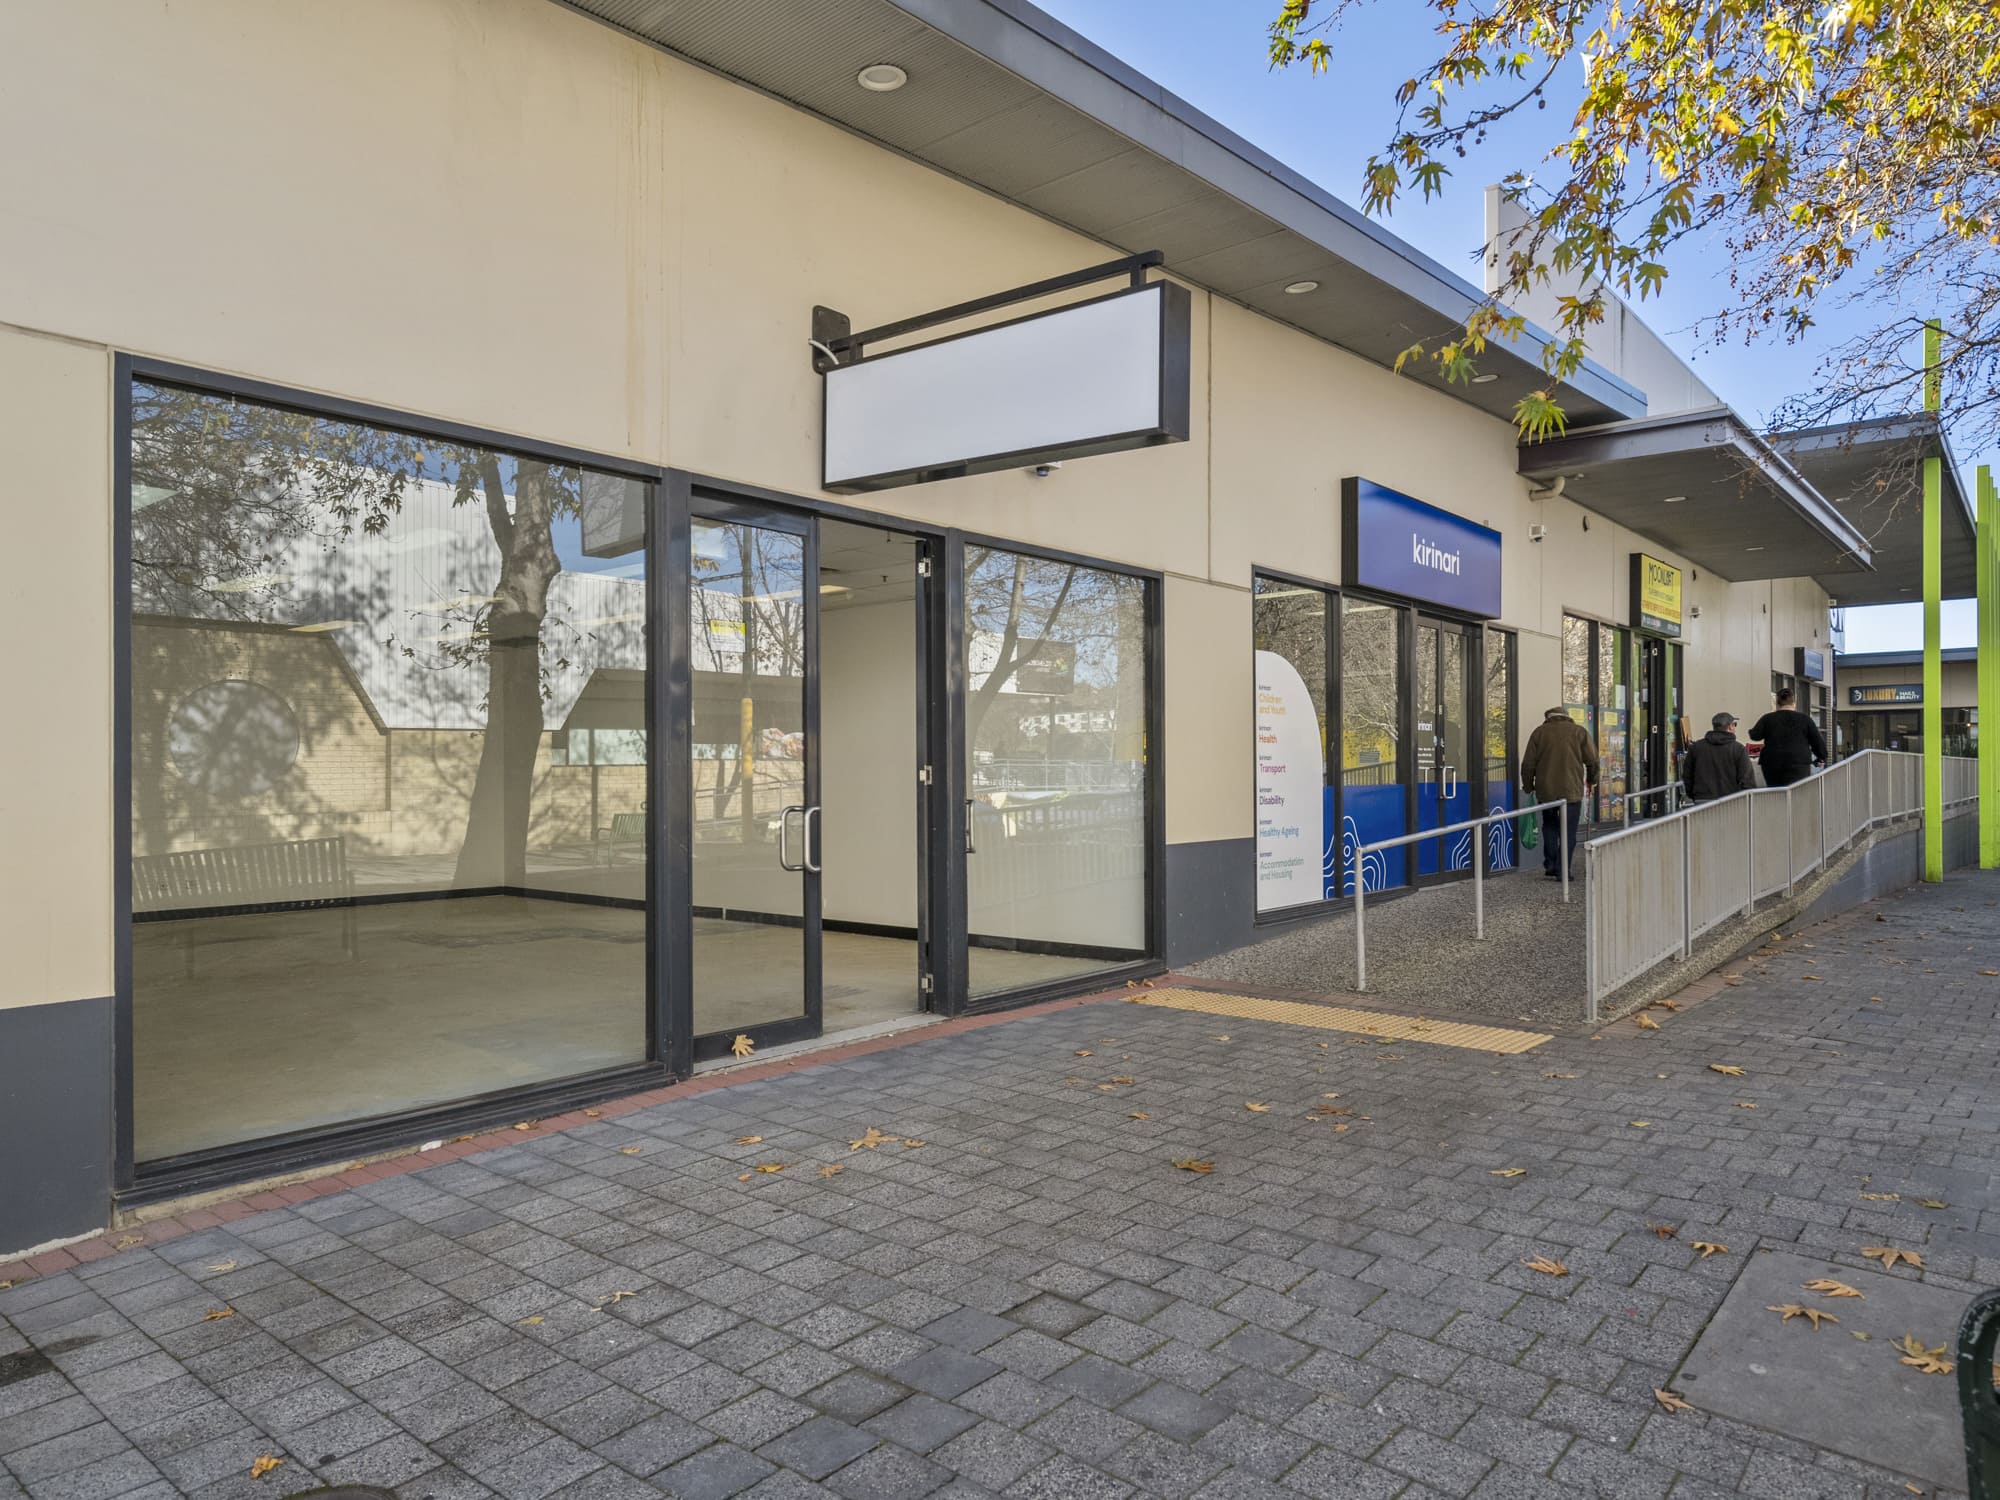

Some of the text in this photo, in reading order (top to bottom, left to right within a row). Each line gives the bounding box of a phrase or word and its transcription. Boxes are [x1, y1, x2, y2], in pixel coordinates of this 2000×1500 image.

[1413, 533, 1460, 576] kirinari
[1862, 687, 1897, 702] LUXURY
[1259, 734, 1277, 744] Health
[1259, 763, 1286, 775] Transport
[1259, 794, 1285, 807] Disability
[1259, 826, 1280, 838] Healthy
